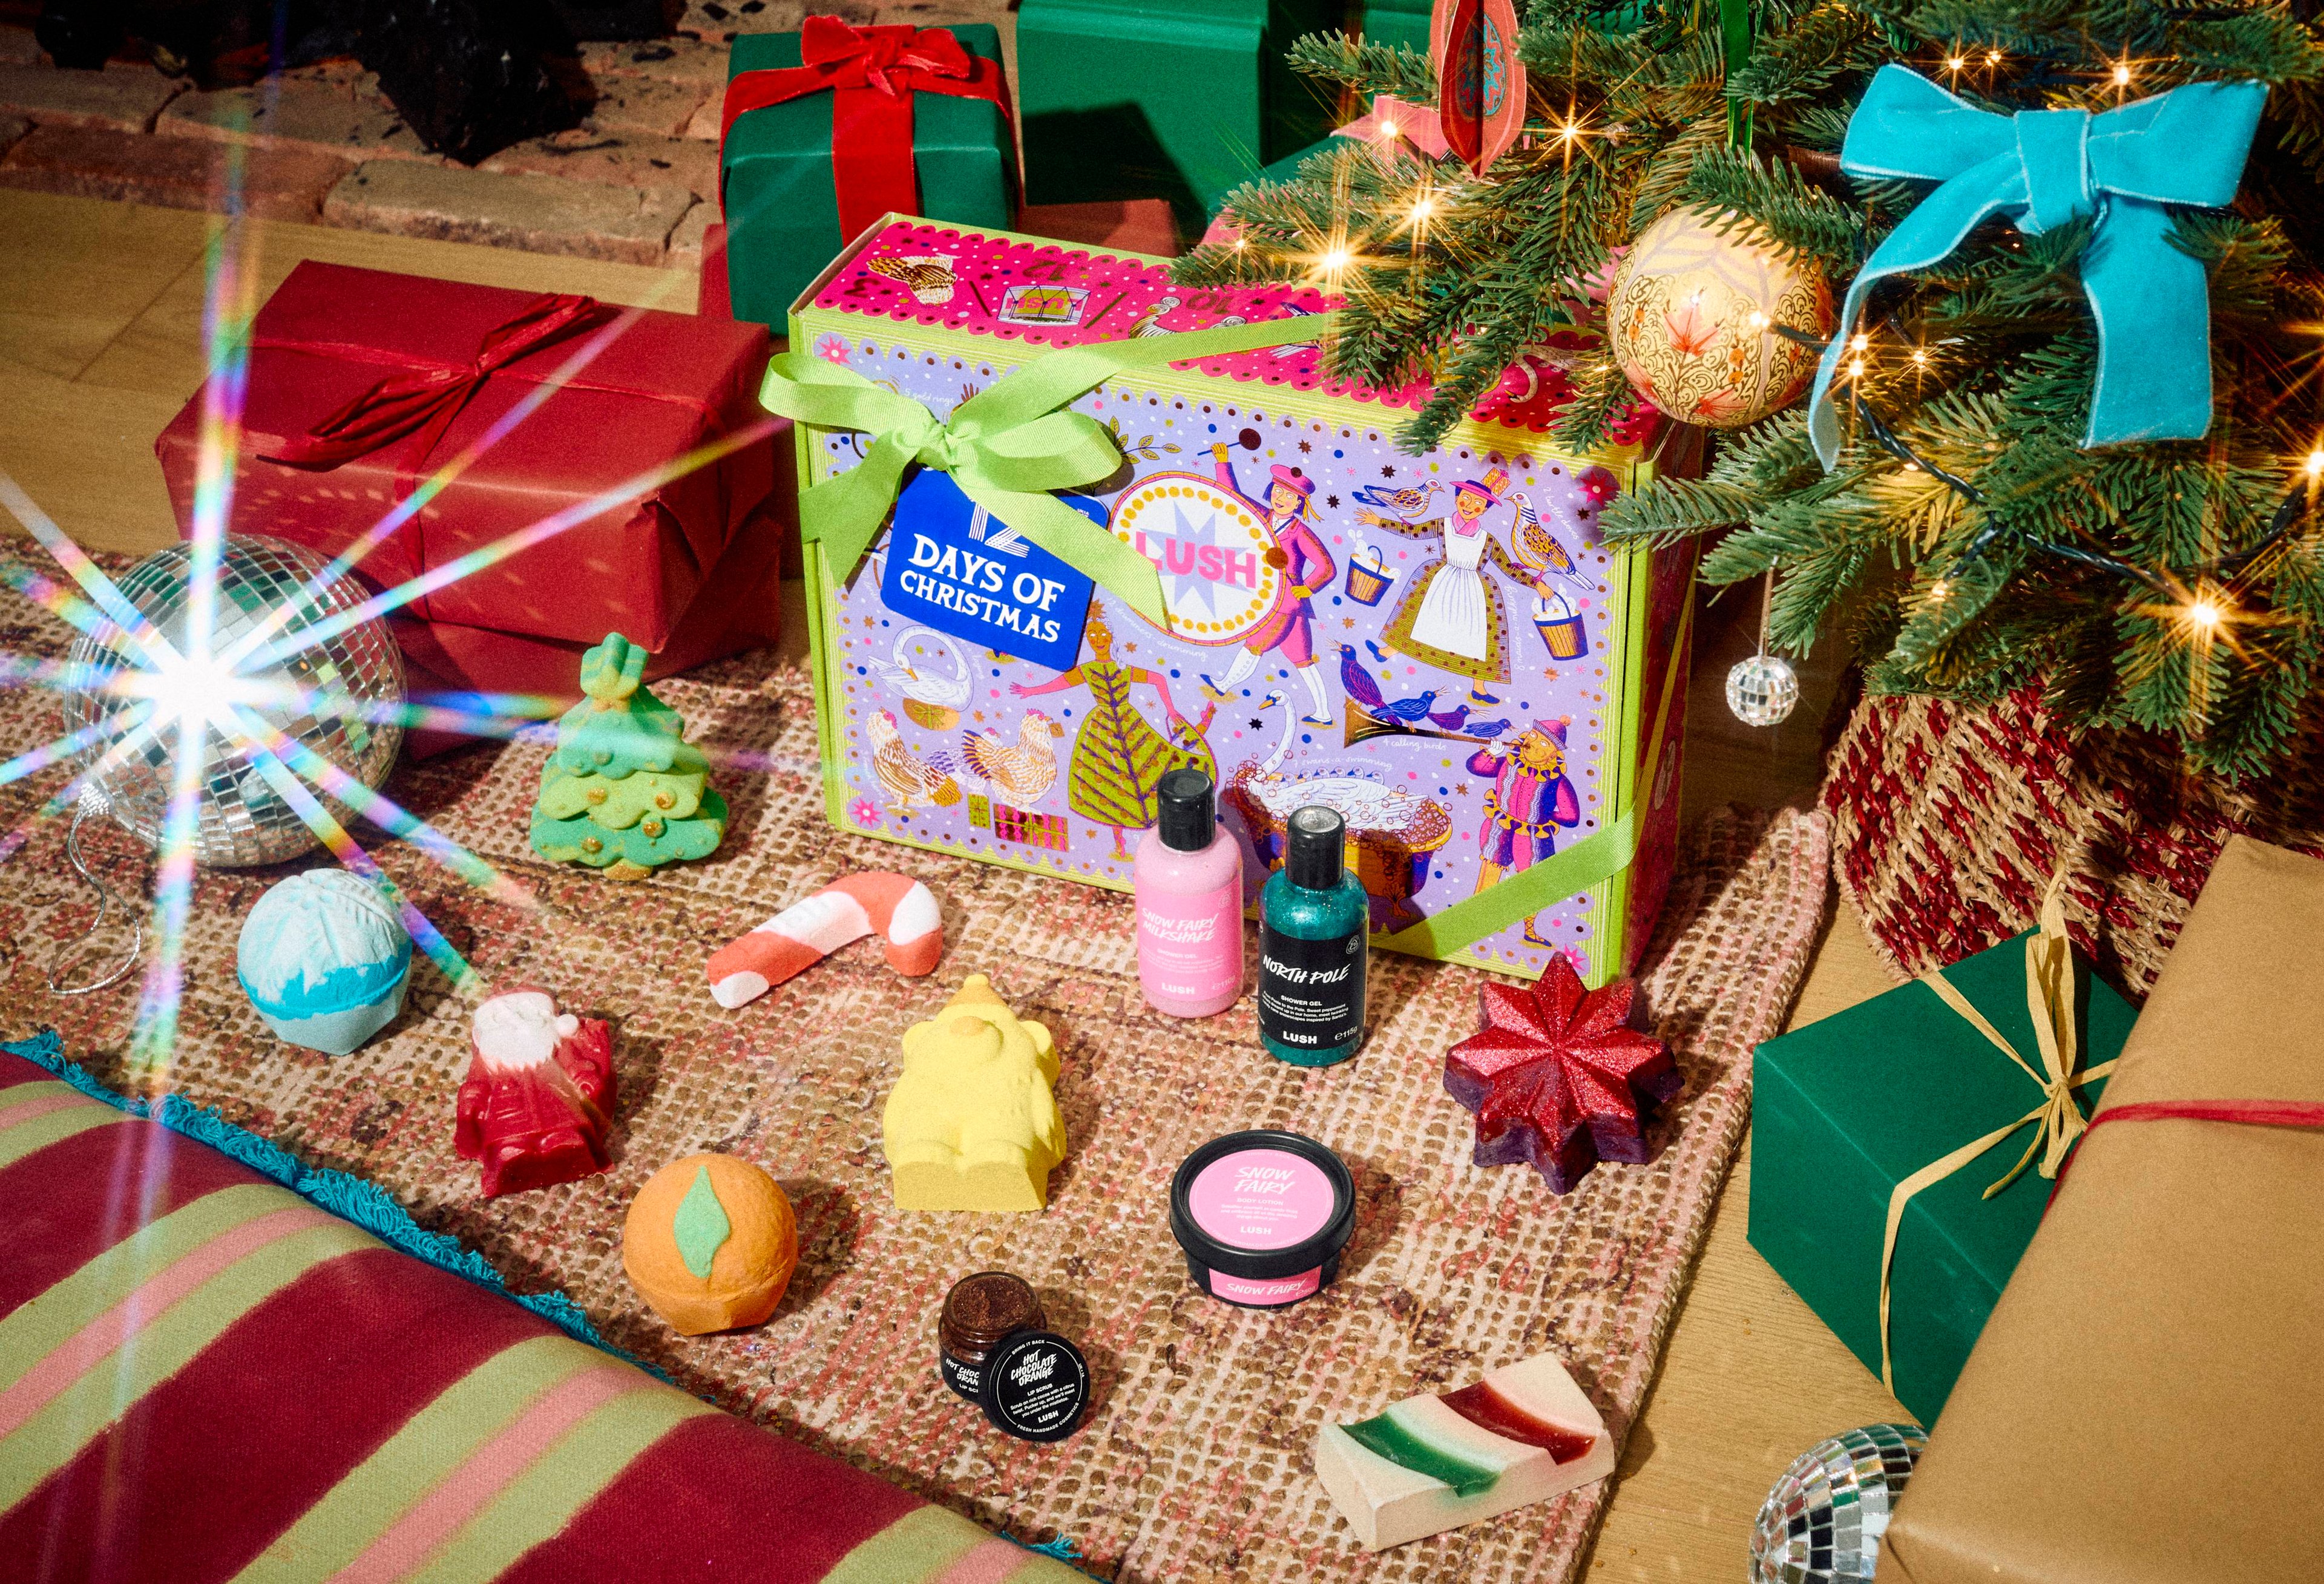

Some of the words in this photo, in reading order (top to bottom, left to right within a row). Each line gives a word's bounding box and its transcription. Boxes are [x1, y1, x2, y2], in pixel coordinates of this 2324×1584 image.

[1135, 531, 1256, 589] LUSH
[908, 532, 1006, 592] DAYS
[1012, 572, 1066, 612] OF
[899, 569, 1062, 643] CHRISTMAS
[1383, 738, 1389, 746] 4
[1391, 738, 1422, 751] calling
[1423, 741, 1447, 751] birds
[1141, 907, 1176, 929] SNOW
[1176, 912, 1219, 931] FAIRY
[1143, 920, 1217, 944] MILKSHAKE
[1262, 954, 1308, 983] NORTH
[1308, 963, 1351, 984] POLE
[1161, 982, 1196, 995] LUSH
[1281, 995, 1308, 1006] SHOWER
[1282, 1030, 1318, 1044] LUSH
[1234, 1167, 1296, 1181] SNOW
[1233, 1179, 1296, 1195] FAIRY
[1240, 1226, 1272, 1235] LUSH
[1226, 1283, 1265, 1295] SNOW
[1267, 1277, 1308, 1296] FAIRY
[1011, 1344, 1026, 1355] BRING
[945, 1358, 960, 1370] HOT
[1022, 1349, 1041, 1366] HOT
[1011, 1353, 1057, 1380] CHOCOLATE
[956, 1372, 979, 1386] ORAN
[1018, 1364, 1054, 1387] ORANGE
[1036, 1383, 1053, 1393] SCRUB
[1010, 1402, 1023, 1410] Scrub
[1024, 1402, 1039, 1411] Pucker
[1030, 1406, 1042, 1415] under
[1017, 1424, 1032, 1433] FRESH
[1032, 1422, 1059, 1433] HANDMADE
[1059, 1402, 1079, 1425] COSMETICS
[1037, 1410, 1059, 1424] LUSH
